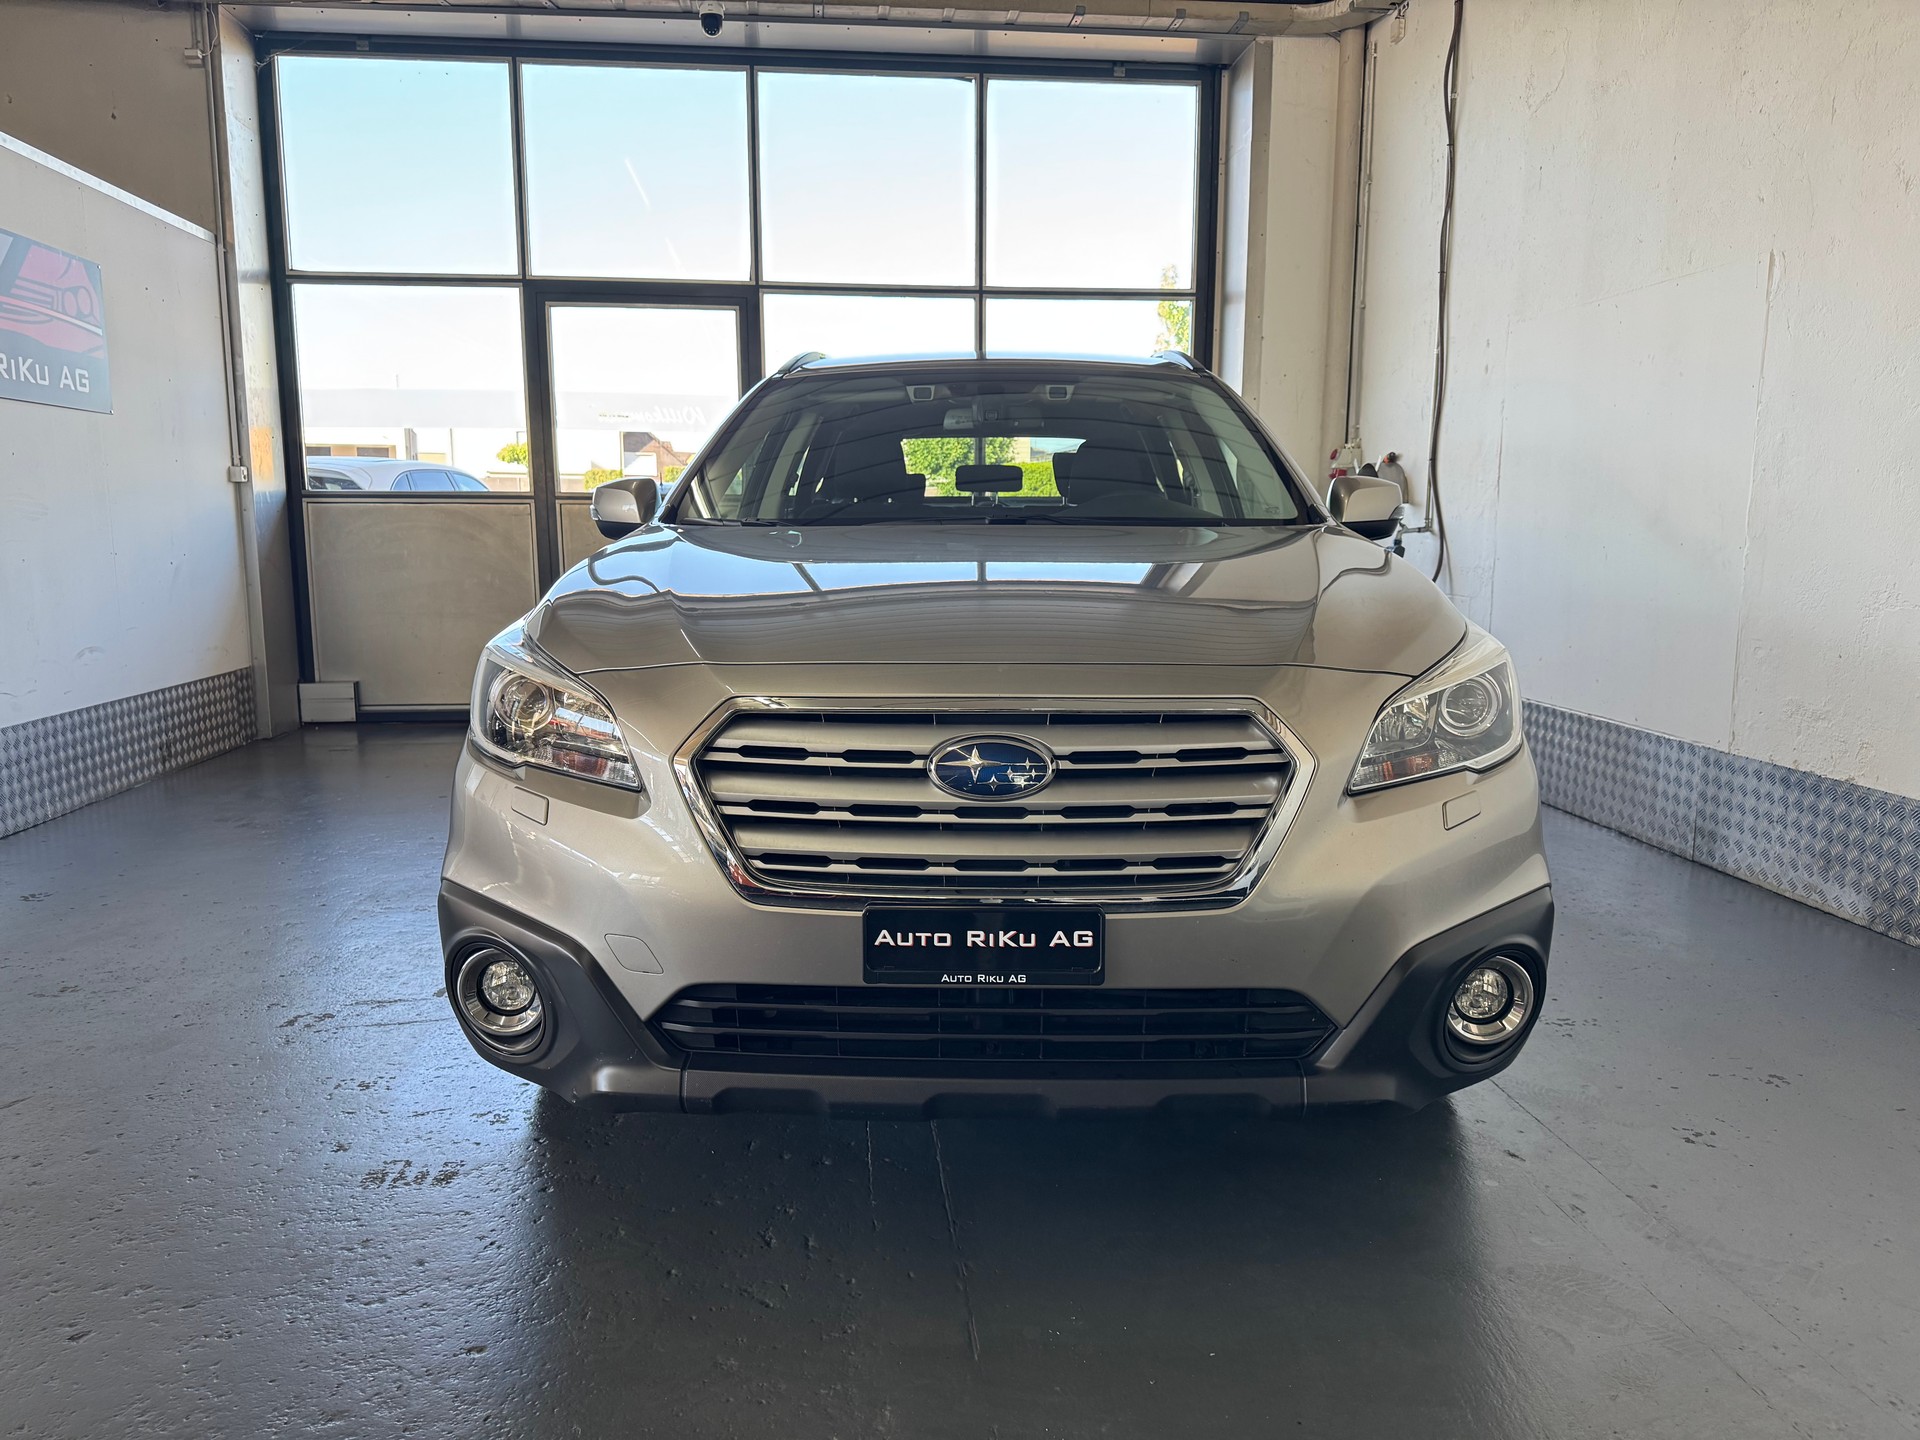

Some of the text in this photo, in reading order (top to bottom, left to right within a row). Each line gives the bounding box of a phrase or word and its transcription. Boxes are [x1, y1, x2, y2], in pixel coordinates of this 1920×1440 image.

[59, 365, 90, 393] AG
[1049, 930, 1094, 947] AG
[1008, 974, 1027, 983] AG
